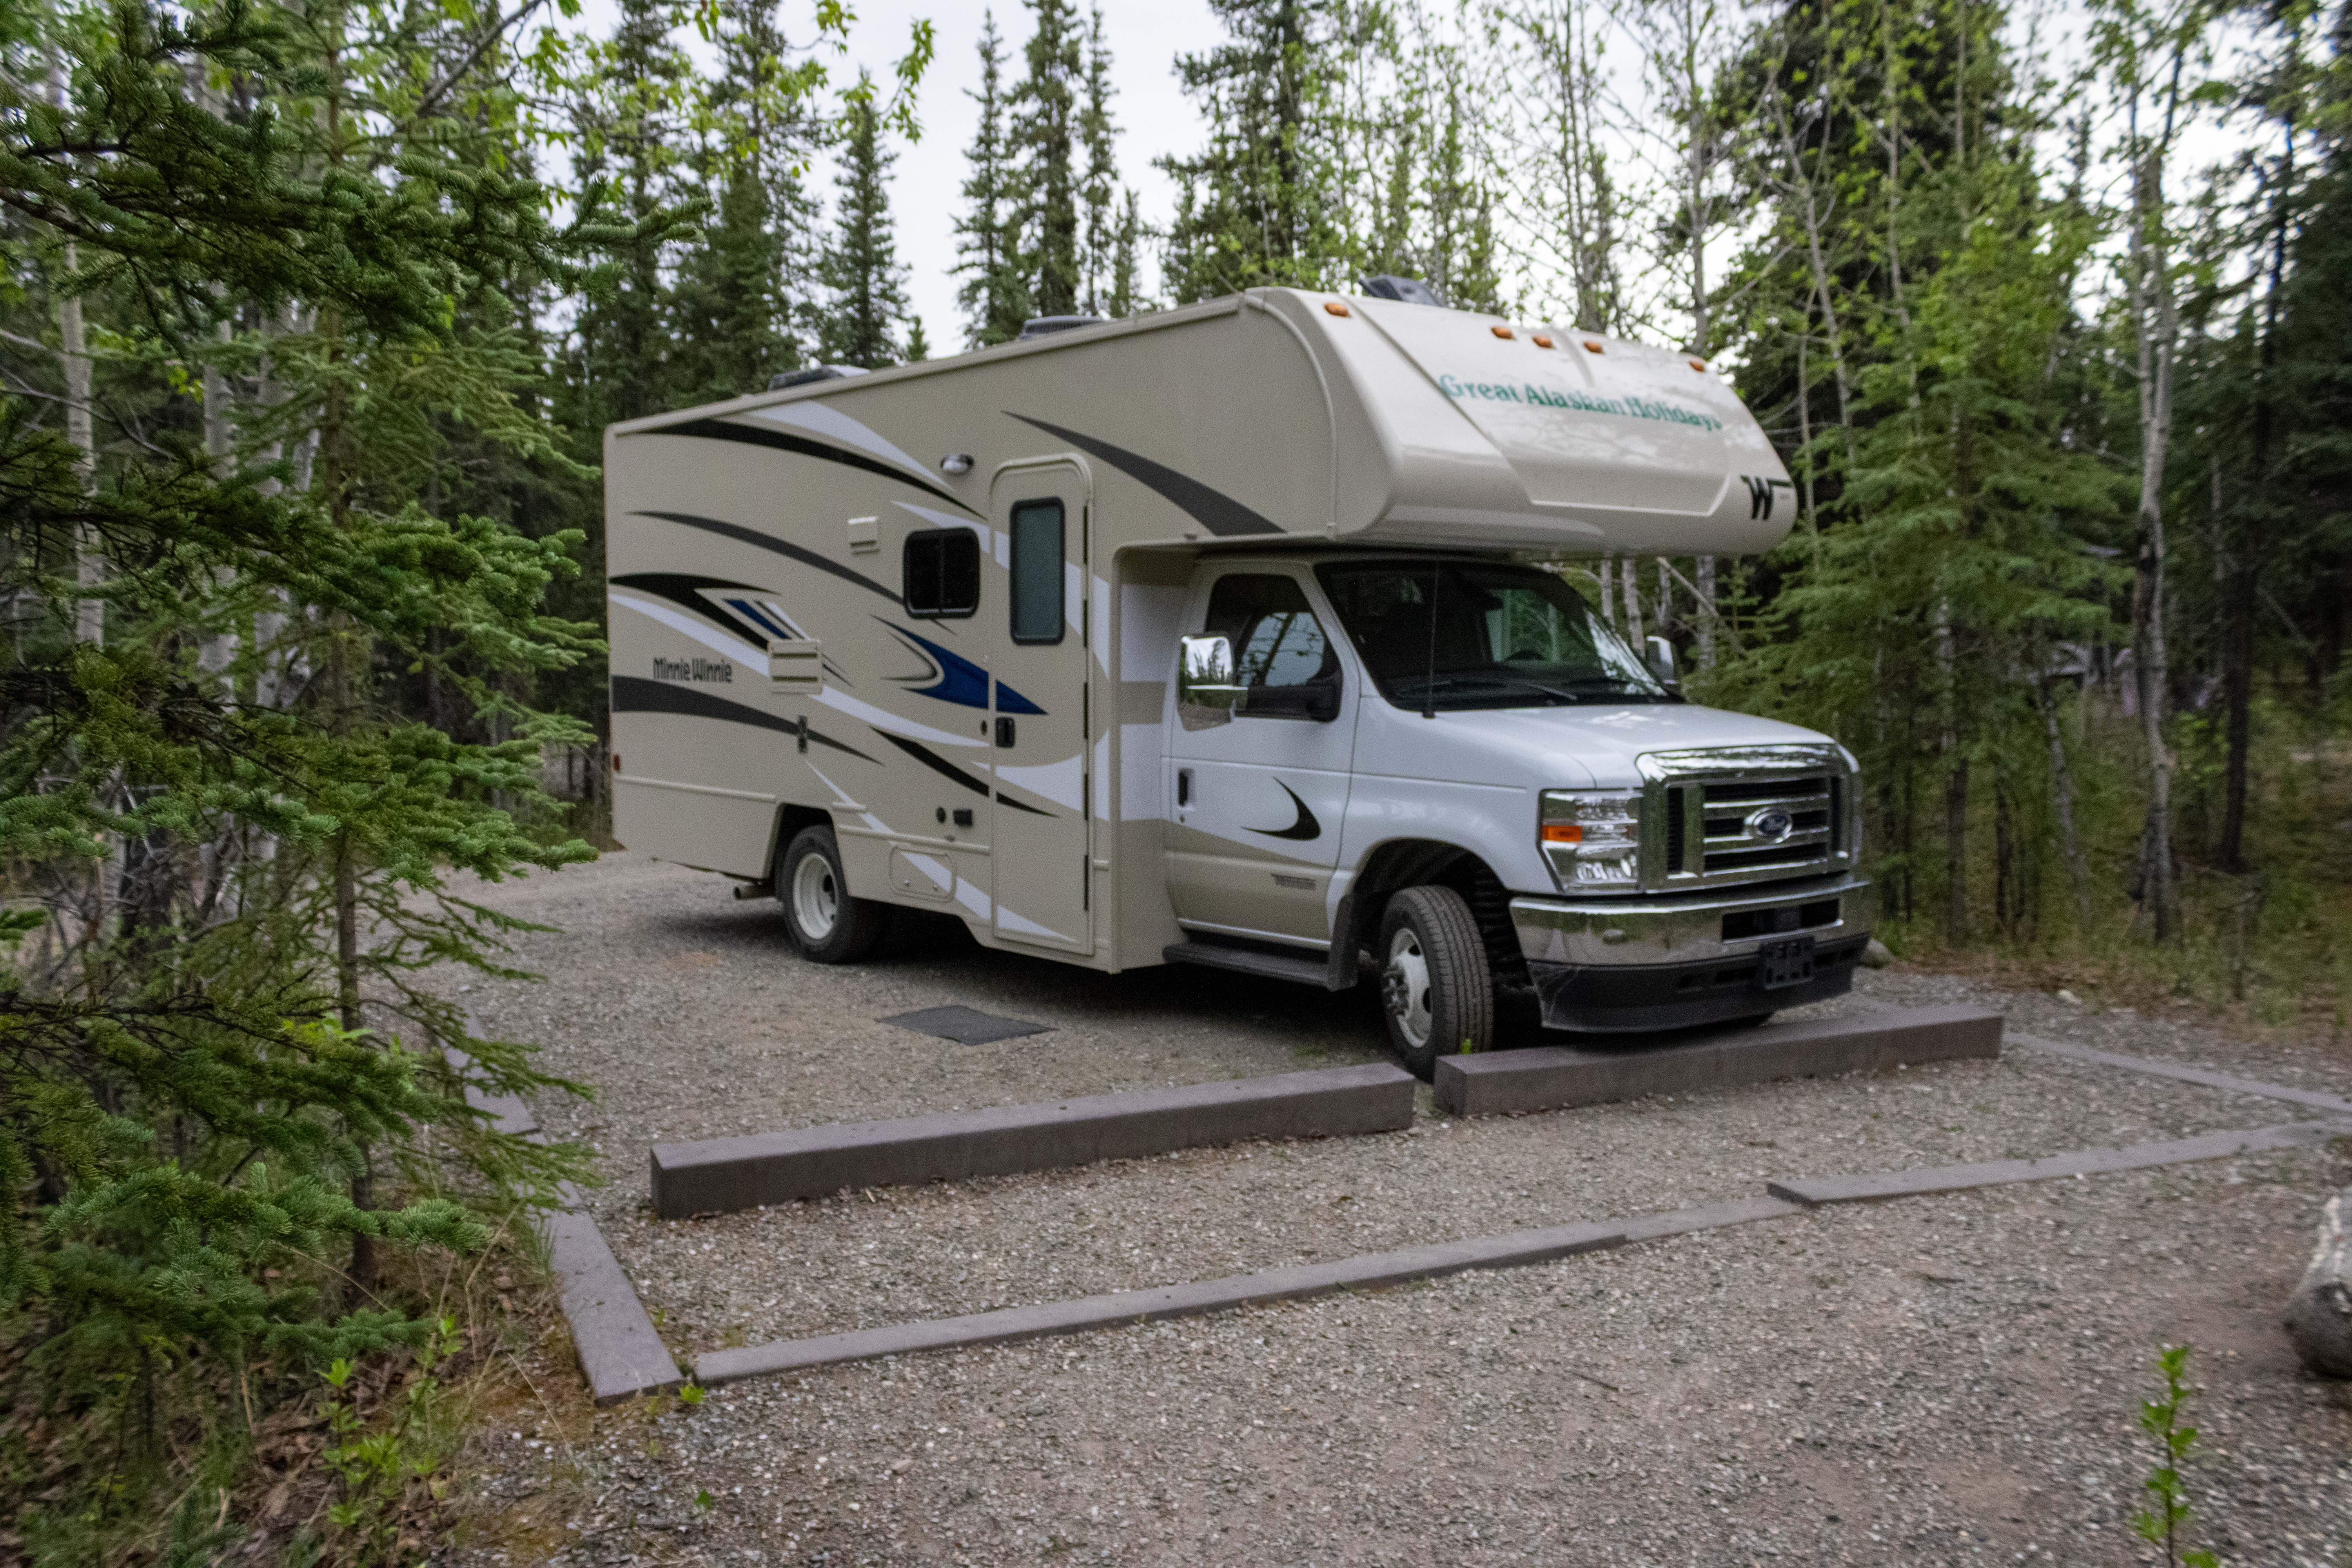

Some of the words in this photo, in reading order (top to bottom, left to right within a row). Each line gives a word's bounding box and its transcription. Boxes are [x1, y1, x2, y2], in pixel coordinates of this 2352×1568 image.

[1440, 374, 1523, 403] Great
[1524, 383, 1626, 415] Alaskan
[1622, 395, 1722, 431] Holidays
[653, 657, 690, 681] Minnie
[691, 658, 732, 683] Winnie
